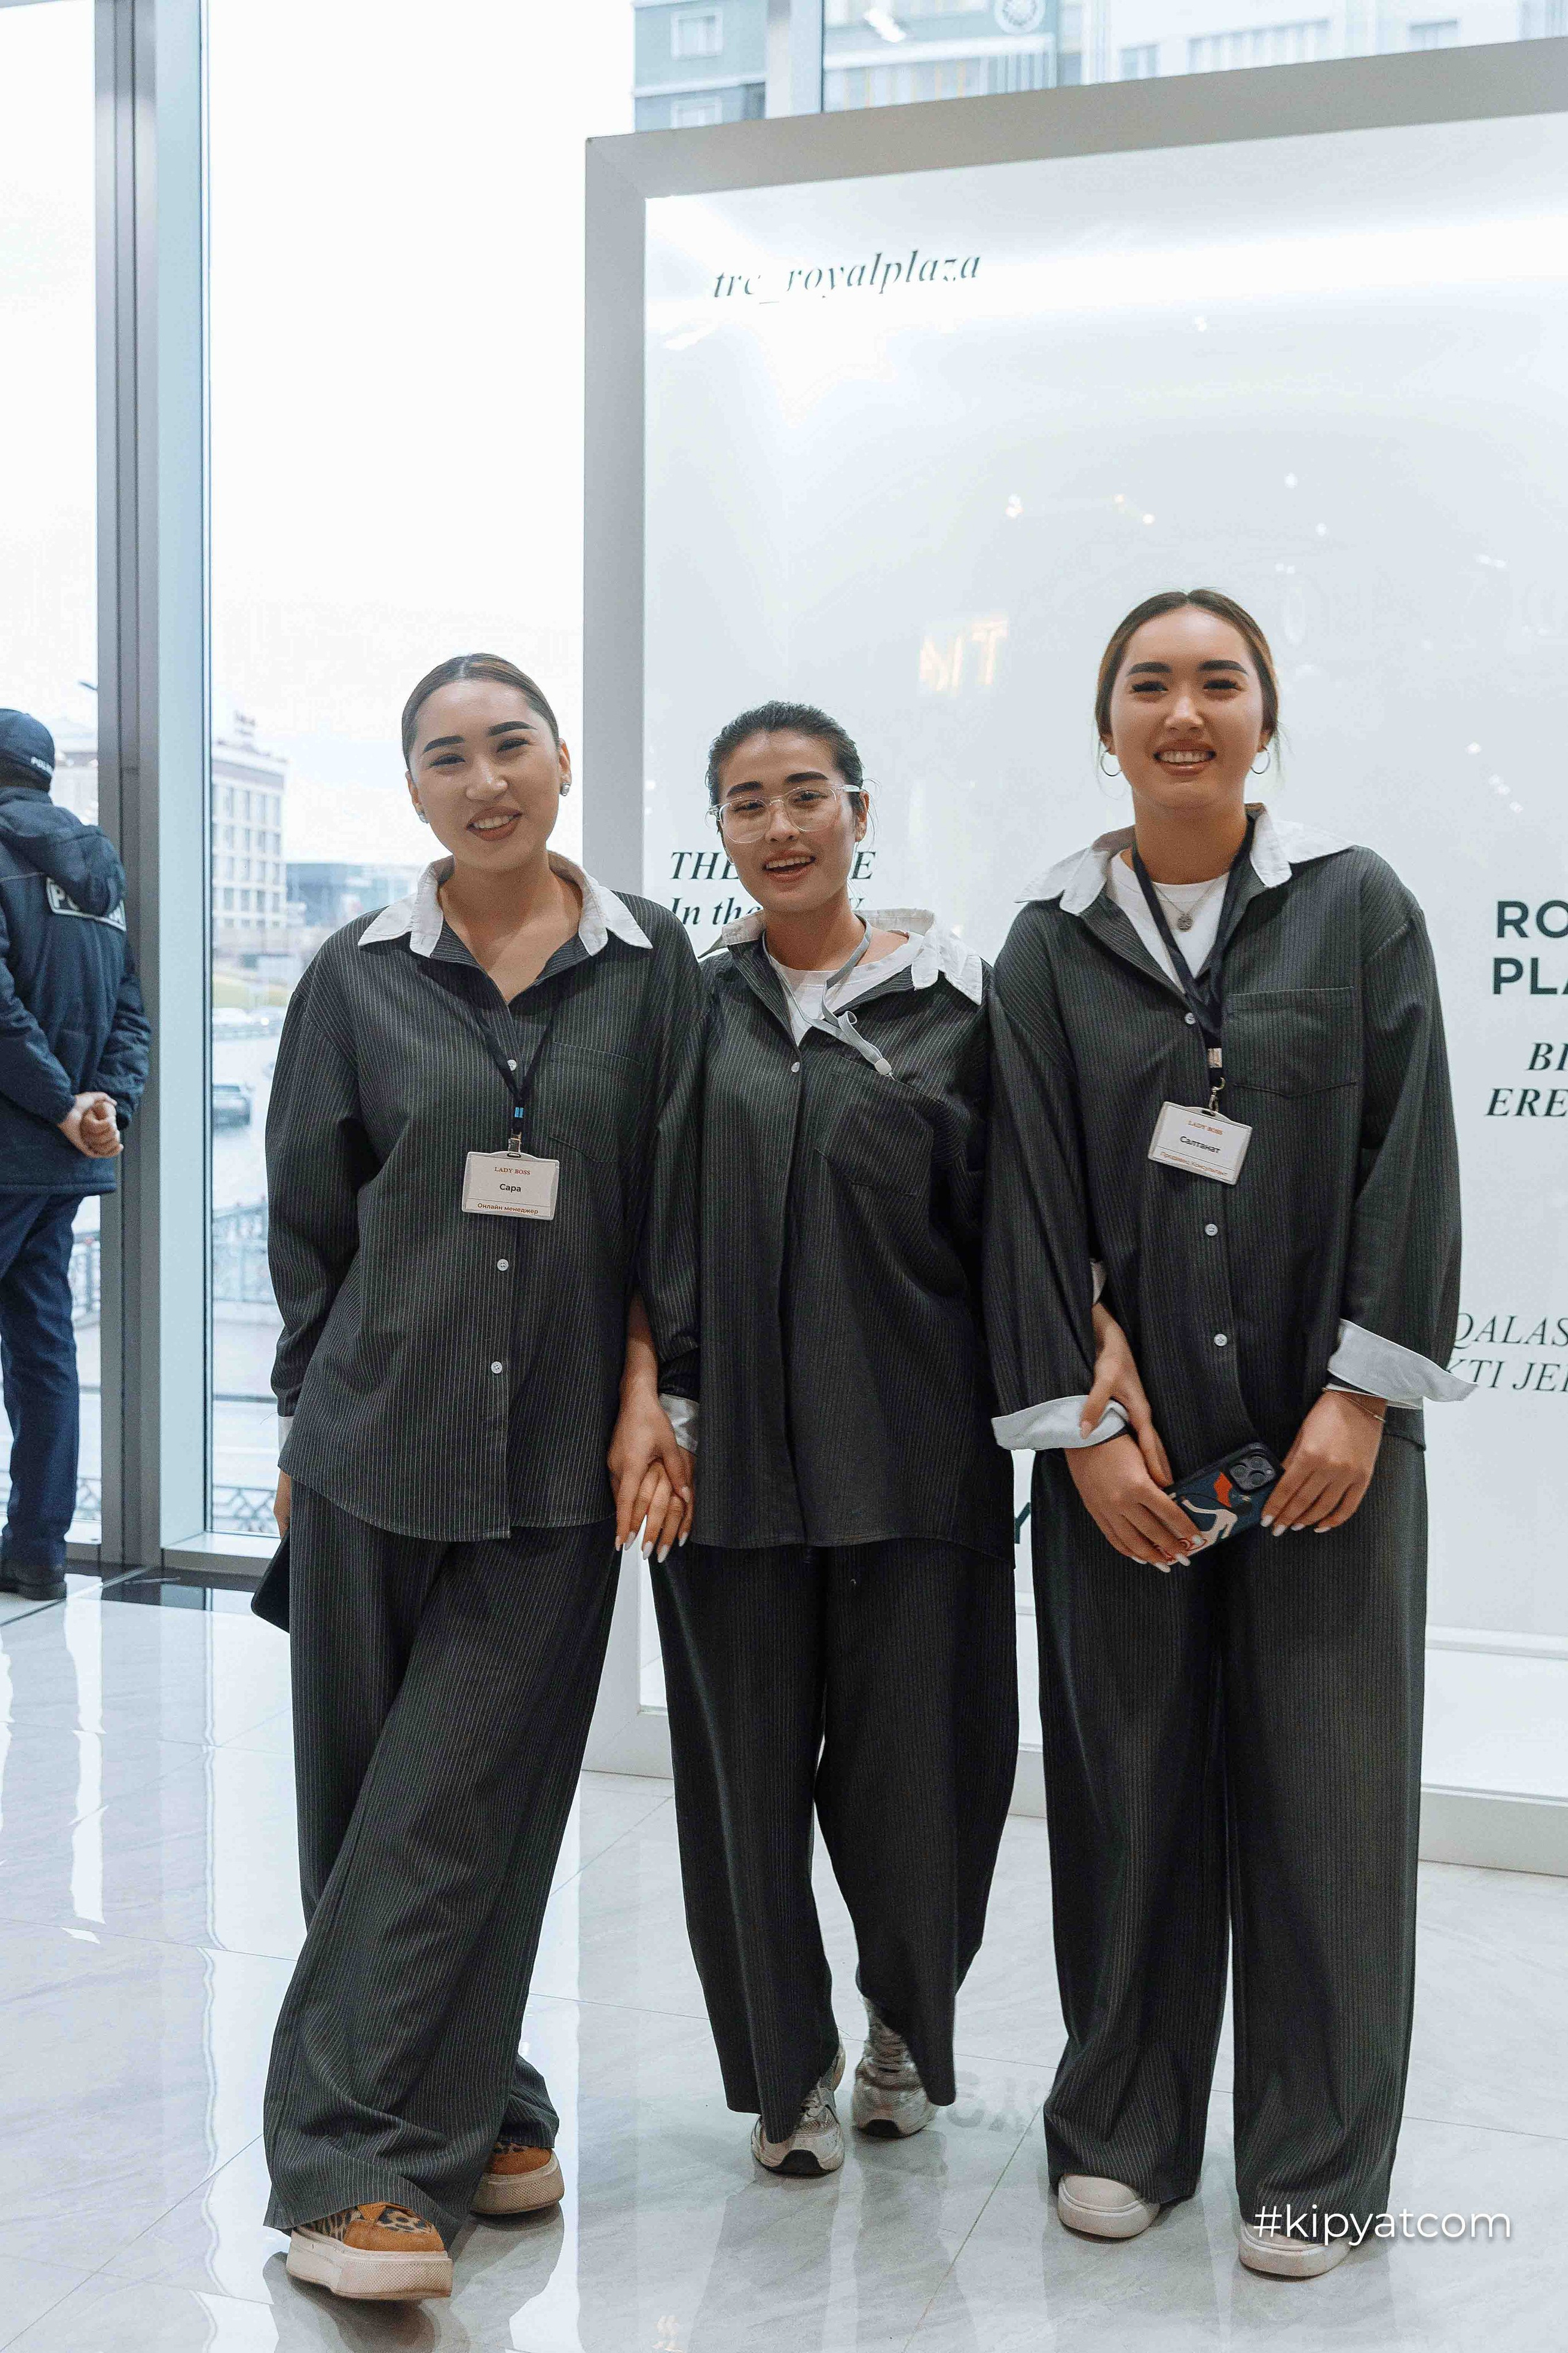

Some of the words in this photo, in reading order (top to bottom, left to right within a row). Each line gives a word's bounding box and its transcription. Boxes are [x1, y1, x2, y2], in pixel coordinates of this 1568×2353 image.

[712, 249, 981, 305] trc_royalplaza
[1496, 900, 1568, 939] RO
[1492, 957, 1568, 995] PL
[1180, 1136, 1221, 1154] Салтанат
[499, 1183, 522, 1193] Сара
